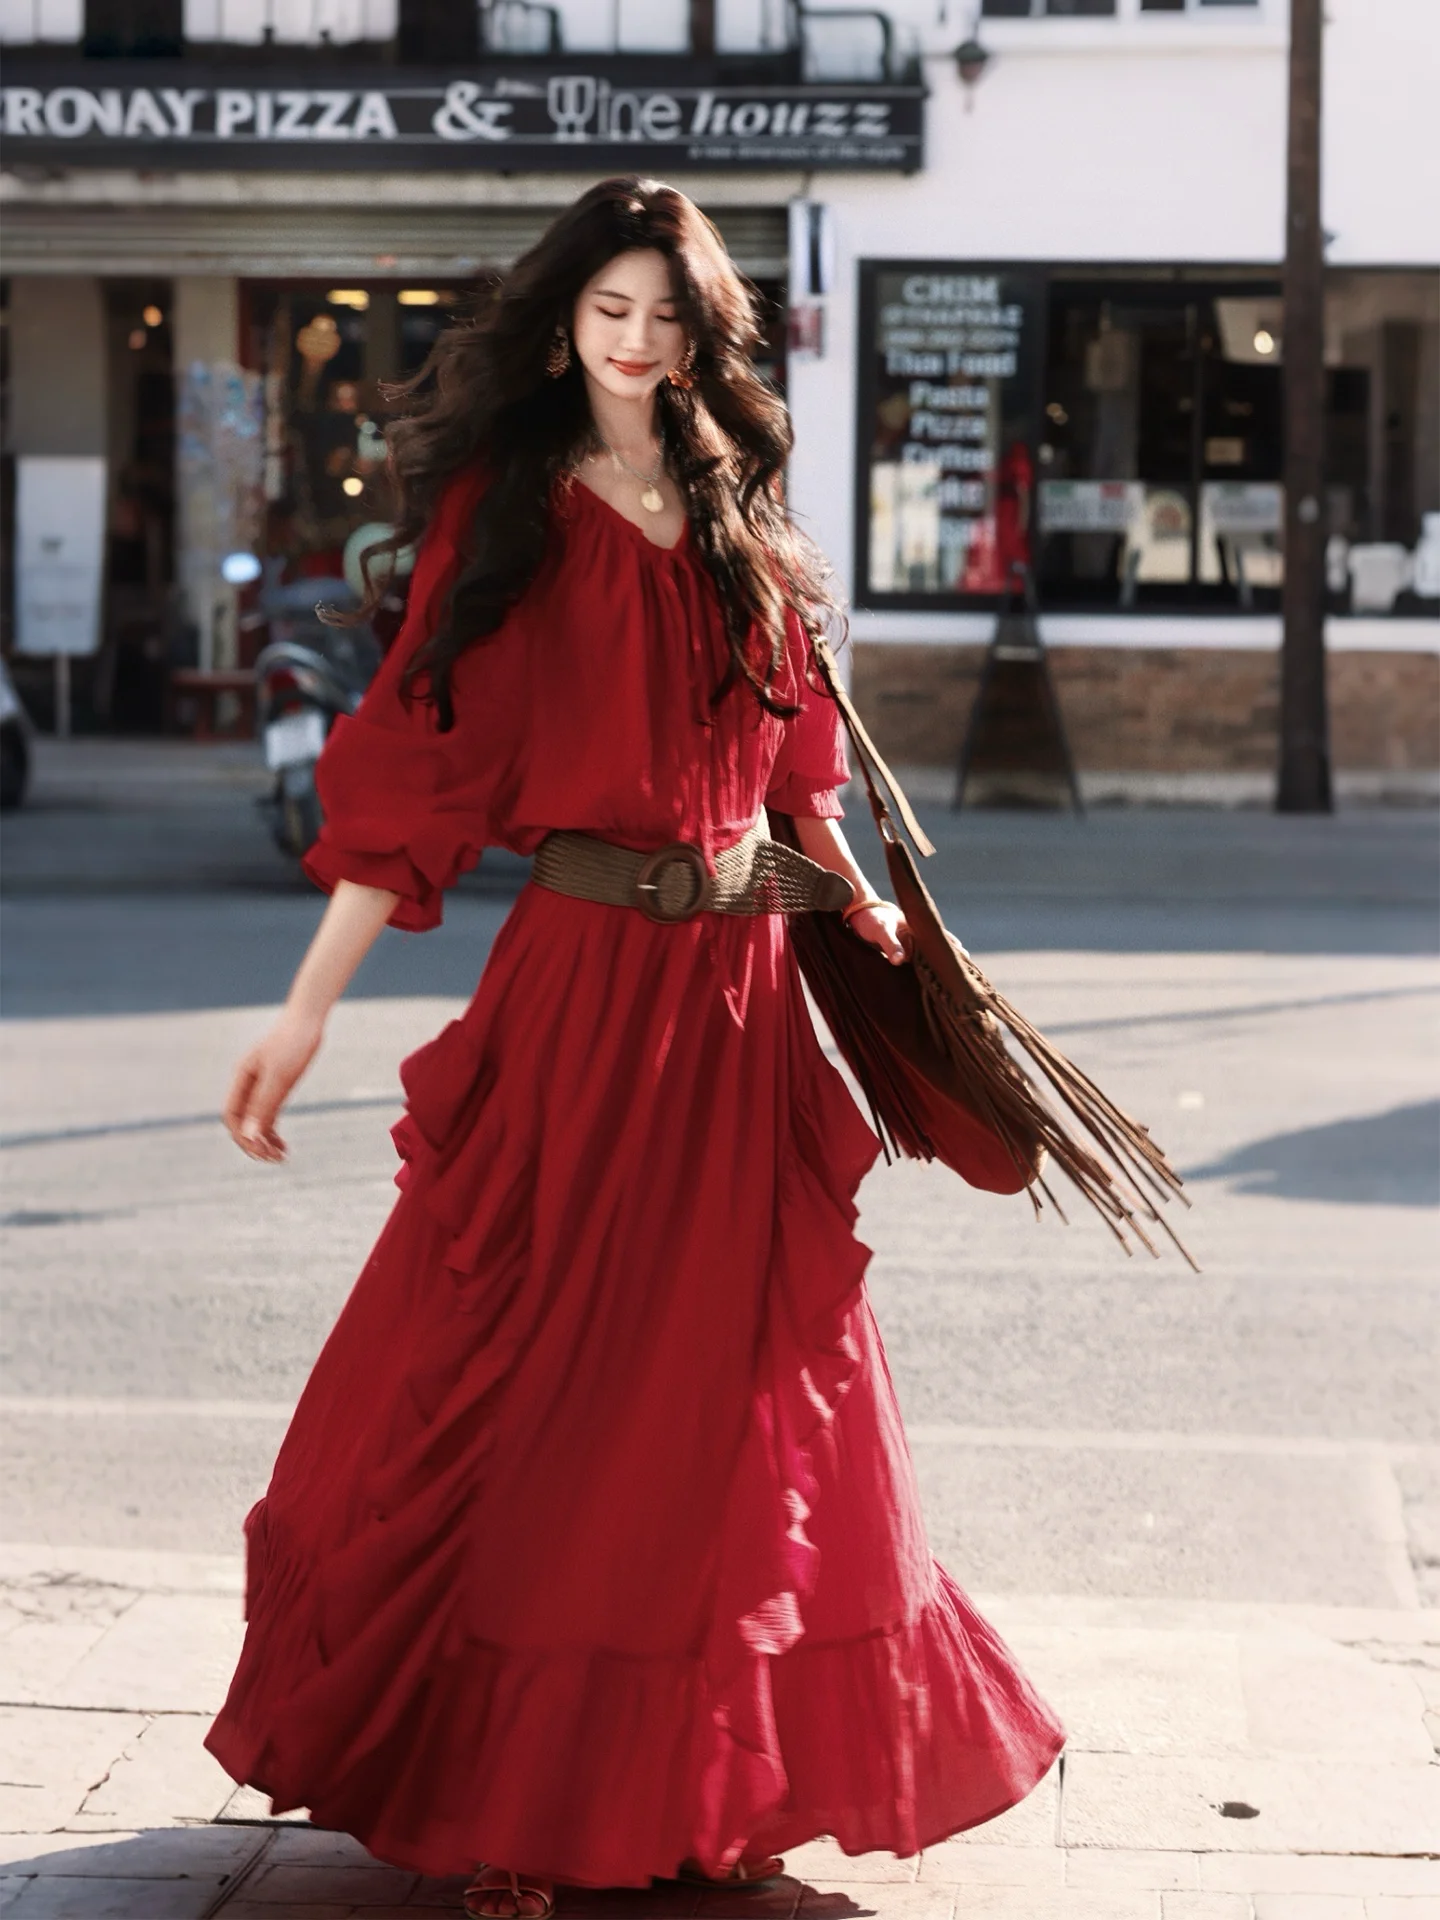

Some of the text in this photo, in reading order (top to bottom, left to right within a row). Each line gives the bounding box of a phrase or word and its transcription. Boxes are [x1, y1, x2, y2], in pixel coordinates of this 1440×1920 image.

[0, 76, 889, 142] RONAY PIZZA & Wine houzz
[887, 349, 1016, 377] Thai Food
[909, 380, 989, 410] Pasta
[910, 410, 987, 439] Pizza
